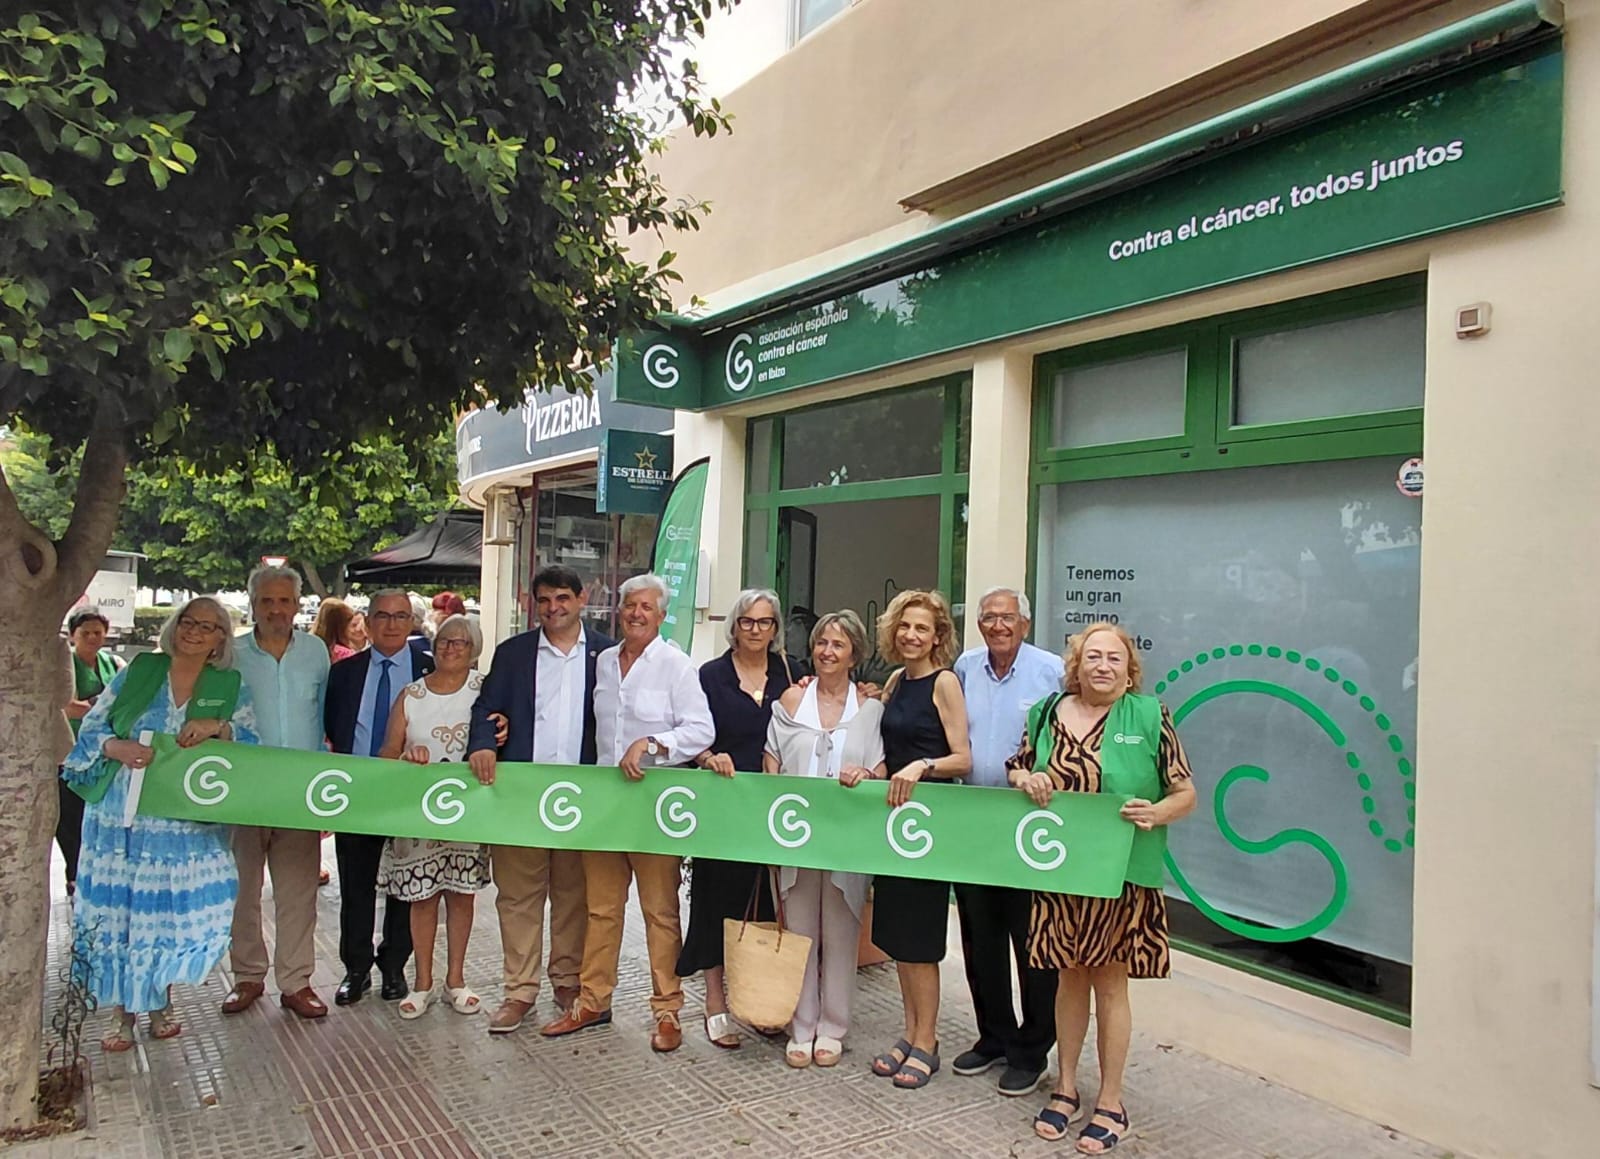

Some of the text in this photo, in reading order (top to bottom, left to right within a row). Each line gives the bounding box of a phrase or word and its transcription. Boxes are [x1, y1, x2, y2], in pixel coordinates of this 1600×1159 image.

[1108, 140, 1464, 261] Contra el cáncer, todos juntos
[758, 321, 803, 345] asociación
[758, 345, 785, 363] contra
[786, 339, 795, 355] el
[758, 366, 786, 382] en Ibiza
[522, 389, 602, 455] PIZZERIA
[1066, 565, 1135, 581] Tenemos
[1065, 589, 1121, 606] un gran
[1065, 611, 1119, 625] camino
